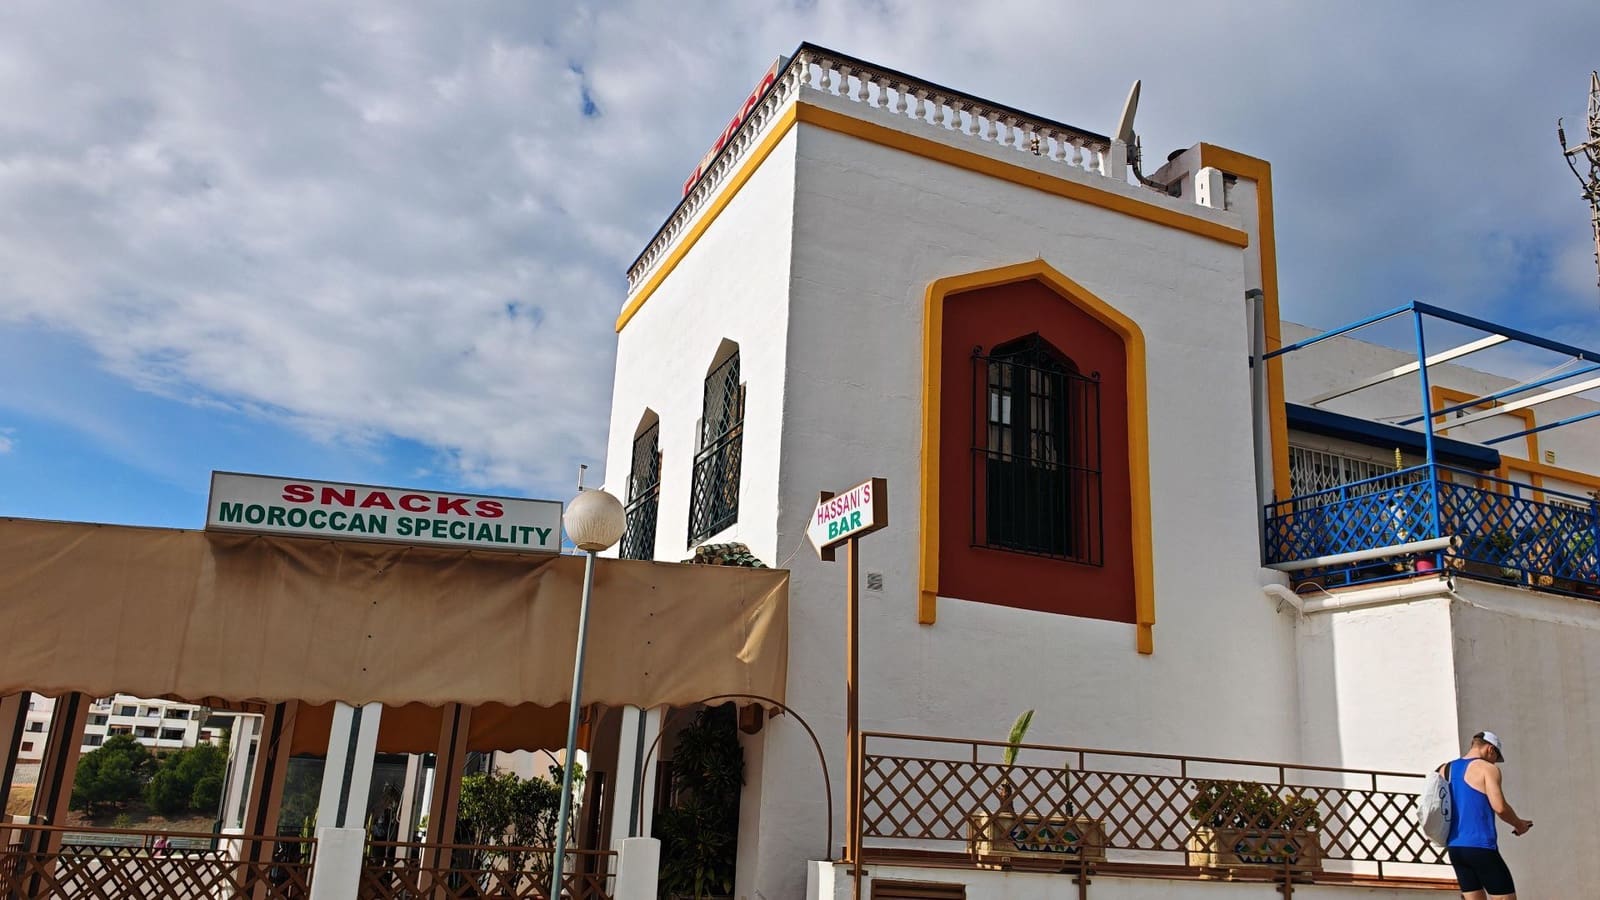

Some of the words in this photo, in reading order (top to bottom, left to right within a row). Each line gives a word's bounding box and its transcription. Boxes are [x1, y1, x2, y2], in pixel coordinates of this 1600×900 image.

[282, 484, 504, 519] SNACKS
[817, 484, 871, 526] HASSANI'S
[219, 502, 387, 534] MOROCCAN
[396, 516, 552, 546] SPECIALITY
[828, 510, 861, 540] BAR
